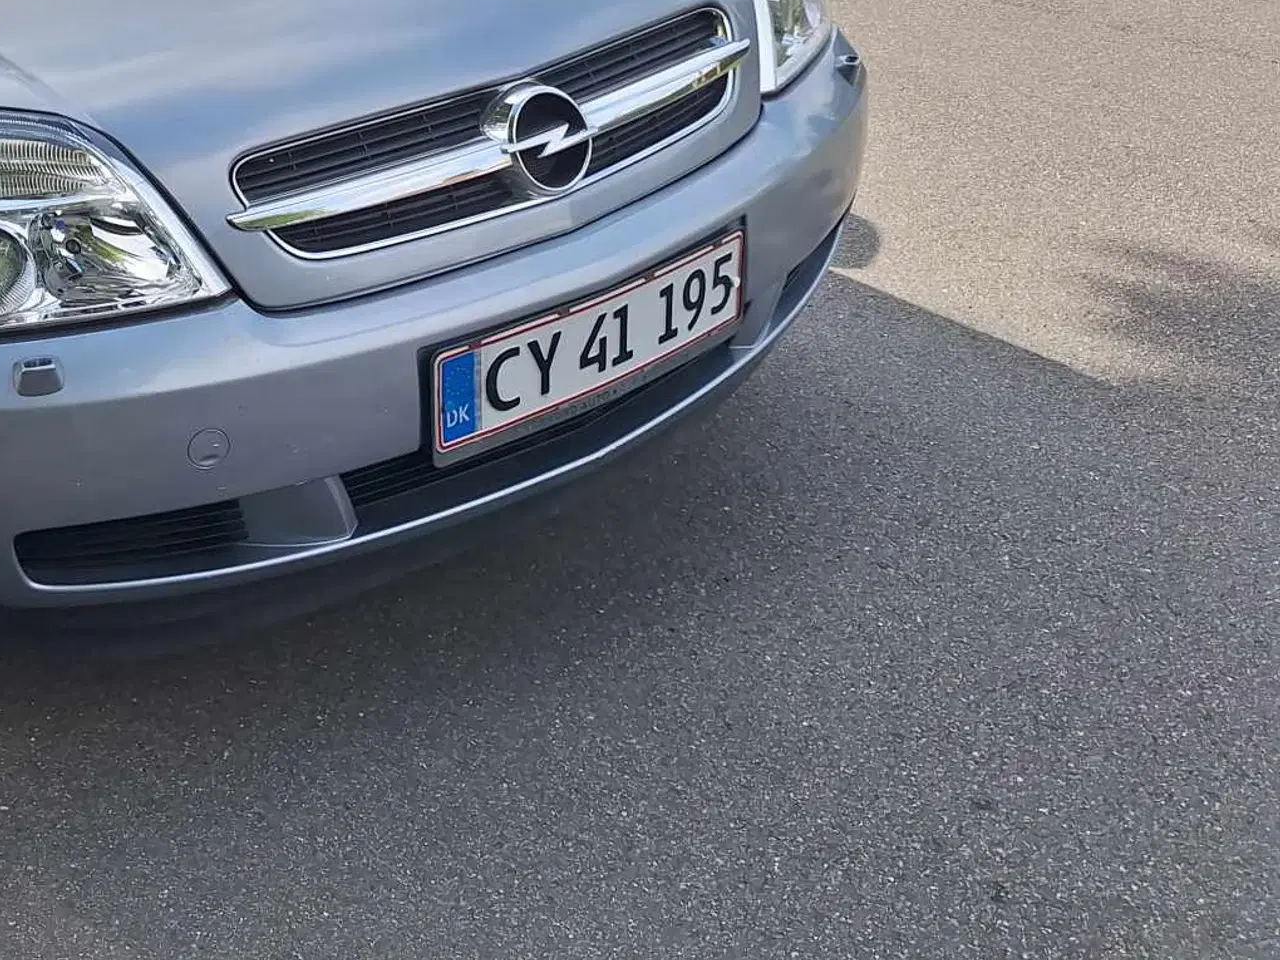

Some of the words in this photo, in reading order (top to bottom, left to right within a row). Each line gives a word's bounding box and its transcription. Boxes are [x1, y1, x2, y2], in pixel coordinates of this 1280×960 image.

[485, 331, 562, 412] CY
[579, 303, 634, 373] 41
[657, 252, 733, 345] 195
[446, 403, 471, 429] DK
